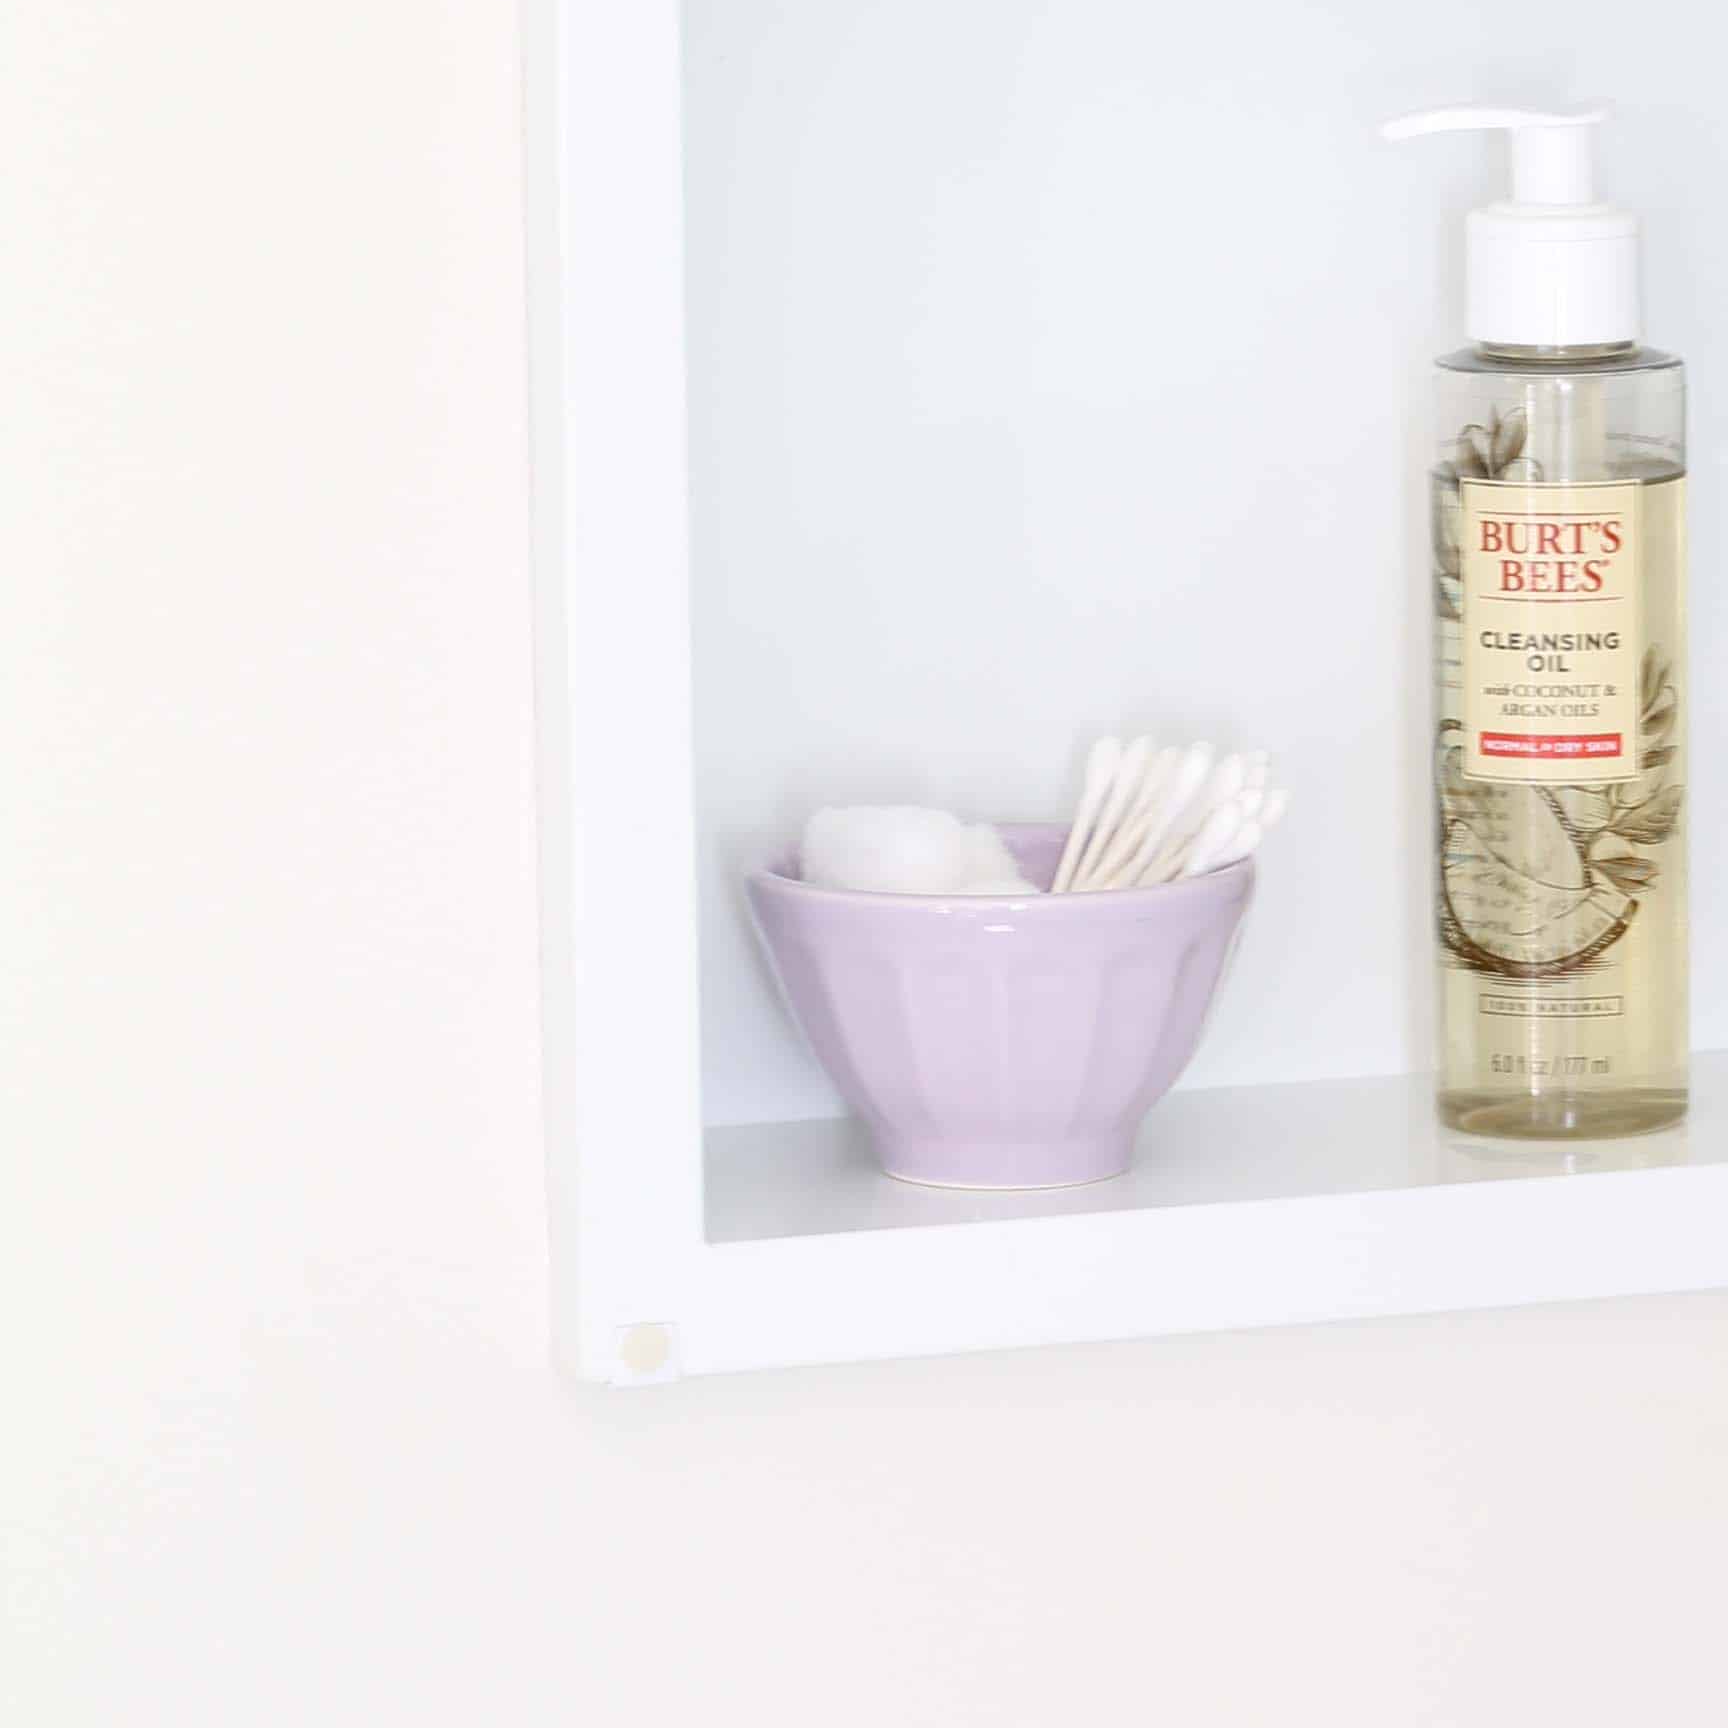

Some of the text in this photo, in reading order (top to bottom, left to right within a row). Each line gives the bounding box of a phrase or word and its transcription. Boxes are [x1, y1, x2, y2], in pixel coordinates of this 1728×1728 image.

[1479, 519, 1624, 555] BURT'S
[1499, 559, 1605, 593] BEES
[1478, 630, 1621, 652] CLEANSING
[1526, 654, 1571, 673] OIL
